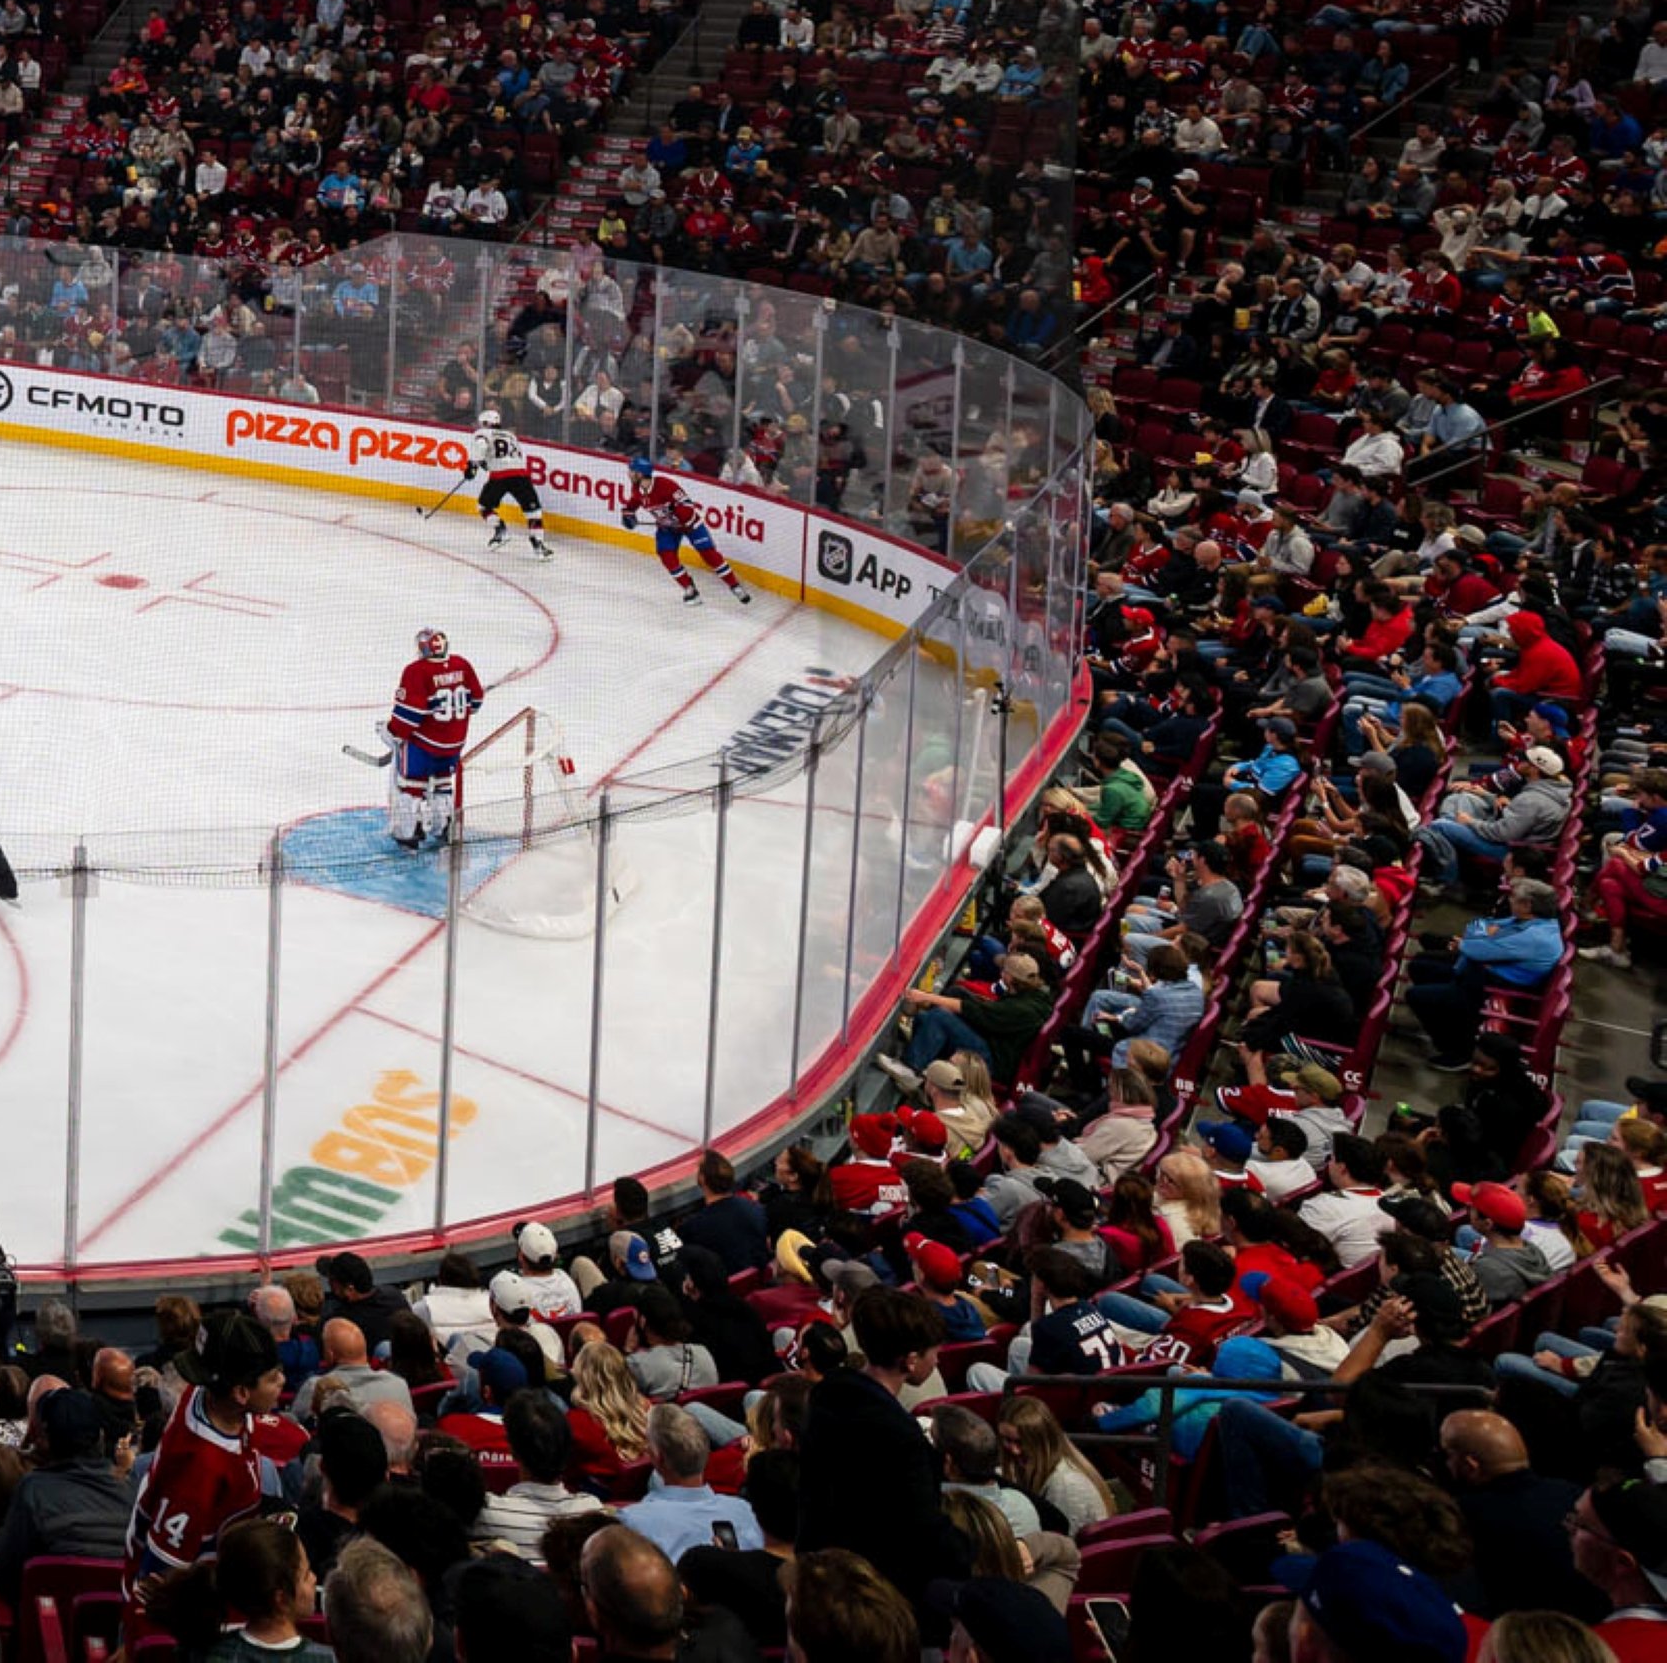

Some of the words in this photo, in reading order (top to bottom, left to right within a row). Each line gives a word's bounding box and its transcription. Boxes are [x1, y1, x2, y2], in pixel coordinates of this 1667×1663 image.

[27, 387, 184, 427] CFMOTO
[227, 407, 340, 453] pizza
[348, 424, 467, 472] pizza
[433, 688, 468, 720] 30
[152, 1498, 190, 1551] 14
